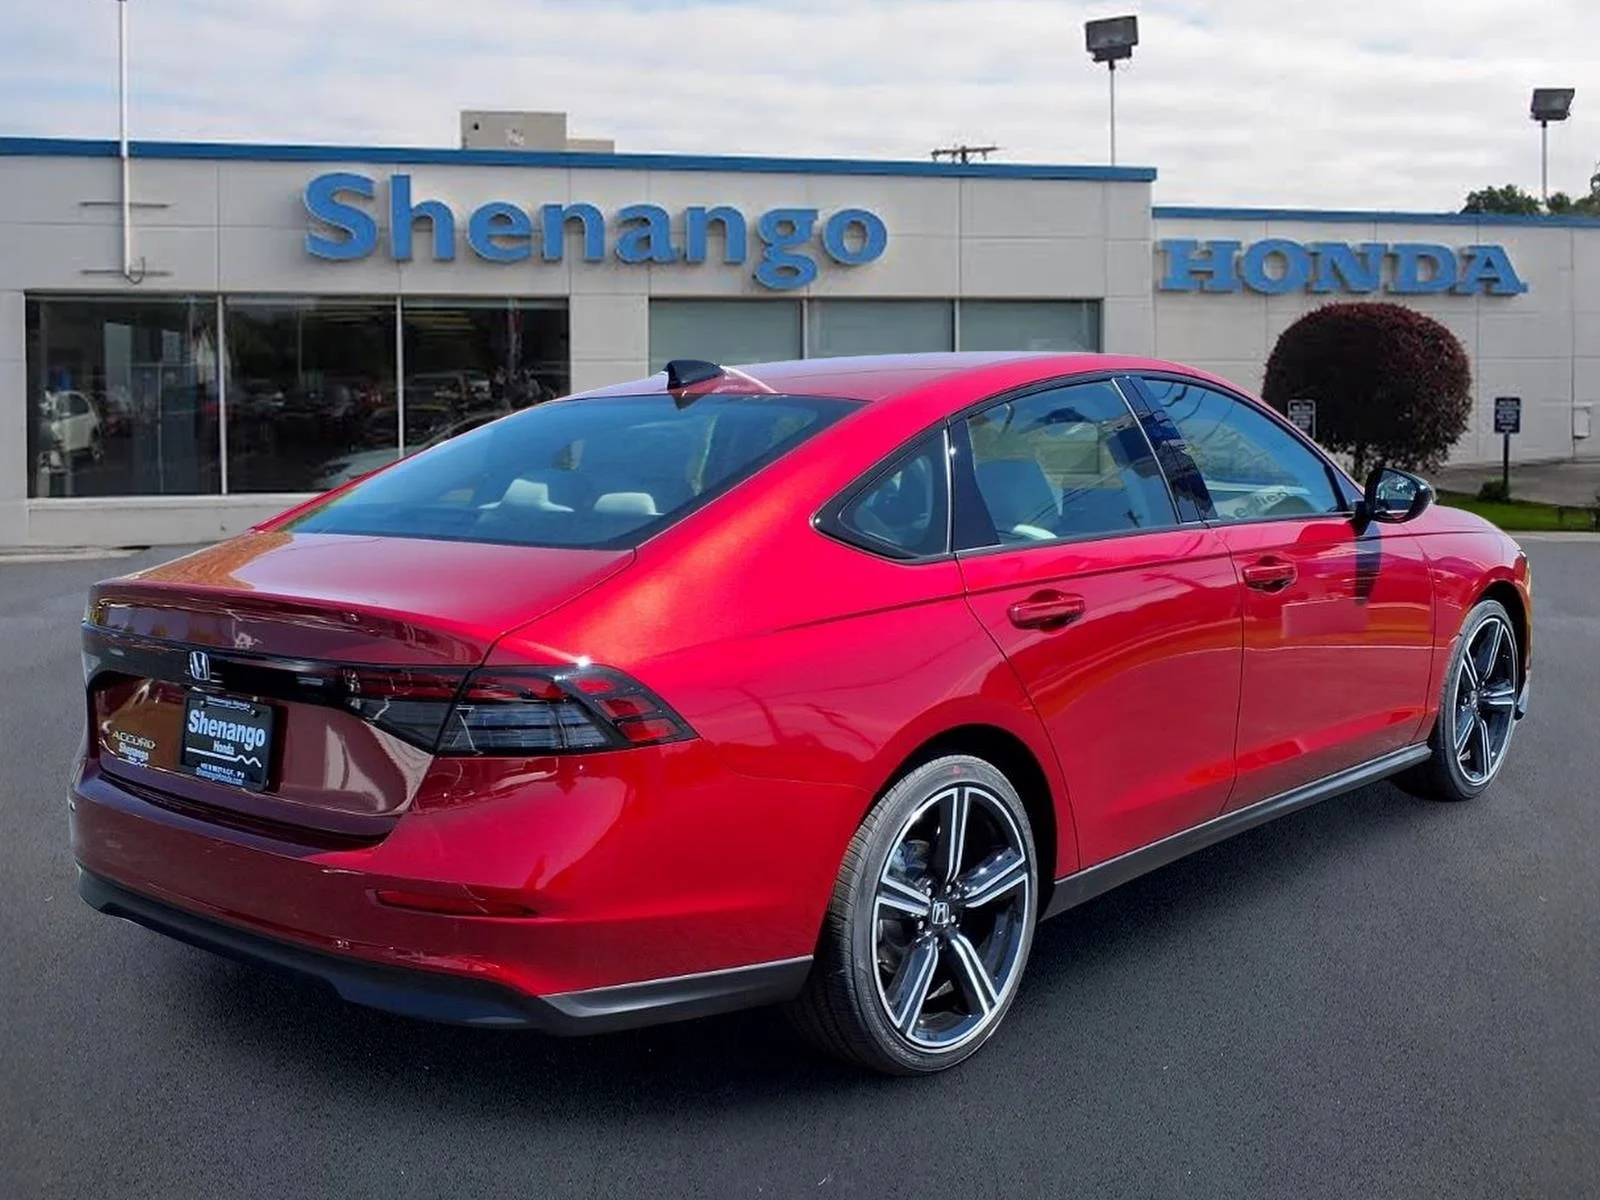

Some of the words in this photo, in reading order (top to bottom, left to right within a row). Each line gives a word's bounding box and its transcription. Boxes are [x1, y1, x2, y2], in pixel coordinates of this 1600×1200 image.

[303, 171, 888, 291] Shenango
[1159, 238, 1528, 295] HONDA
[112, 730, 156, 750] ACCORD
[188, 709, 266, 751] Shenango
[213, 740, 235, 755] Honda
